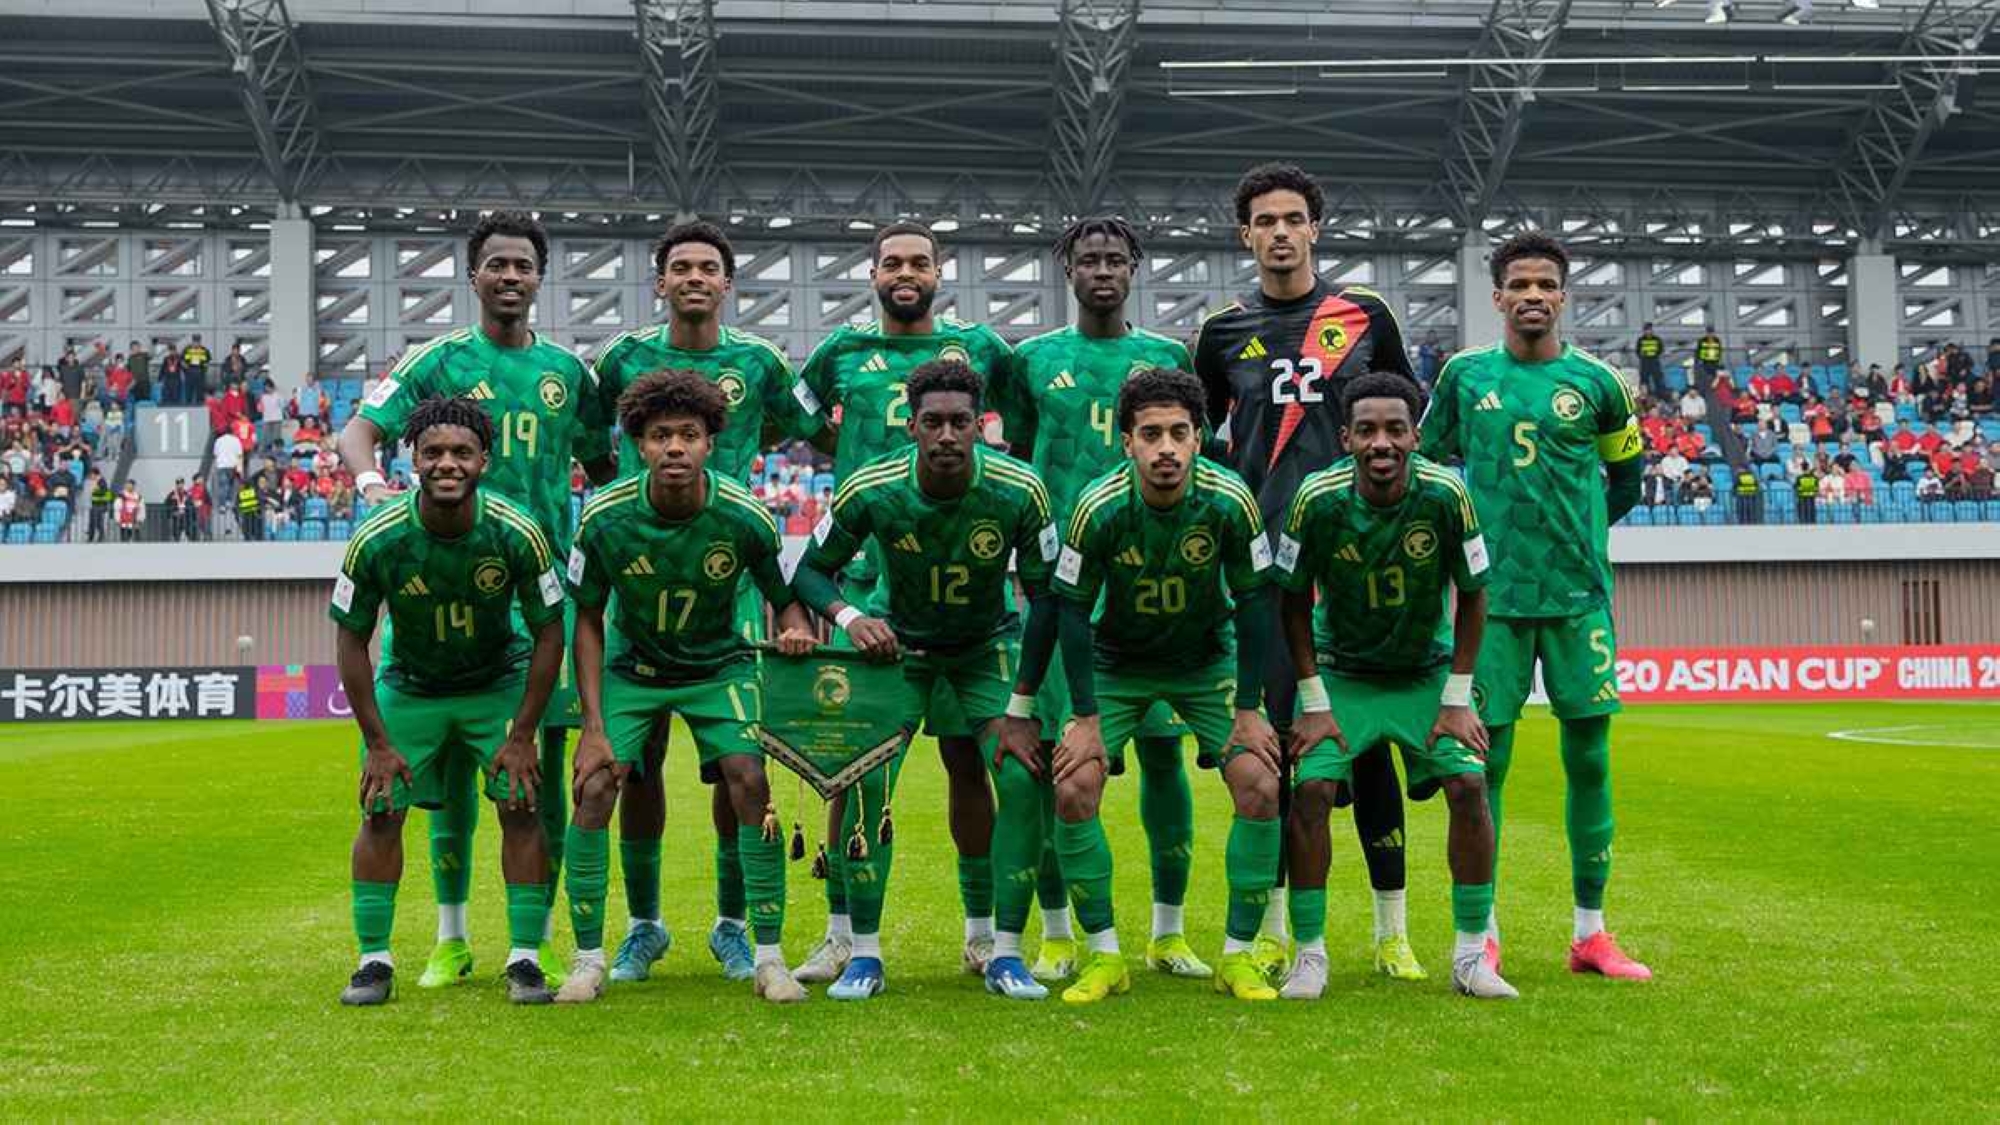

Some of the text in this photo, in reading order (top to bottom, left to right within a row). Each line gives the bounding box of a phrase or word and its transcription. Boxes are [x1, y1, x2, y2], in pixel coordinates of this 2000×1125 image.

[1271, 358, 1324, 404] 22
[154, 411, 189, 453] 11
[503, 411, 538, 457] 19
[1091, 401, 1113, 446] 4
[1514, 422, 1537, 467] 5
[931, 565, 970, 604] 12
[1136, 576, 1186, 614] 20
[1367, 566, 1405, 609] 13
[435, 603, 474, 641] 14
[657, 588, 697, 632] 17
[1589, 628, 1612, 674] 5
[1, 672, 239, 719] 卡尔美体育
[1665, 658, 1790, 691] ASIAN
[1898, 656, 1973, 689] CHINA
